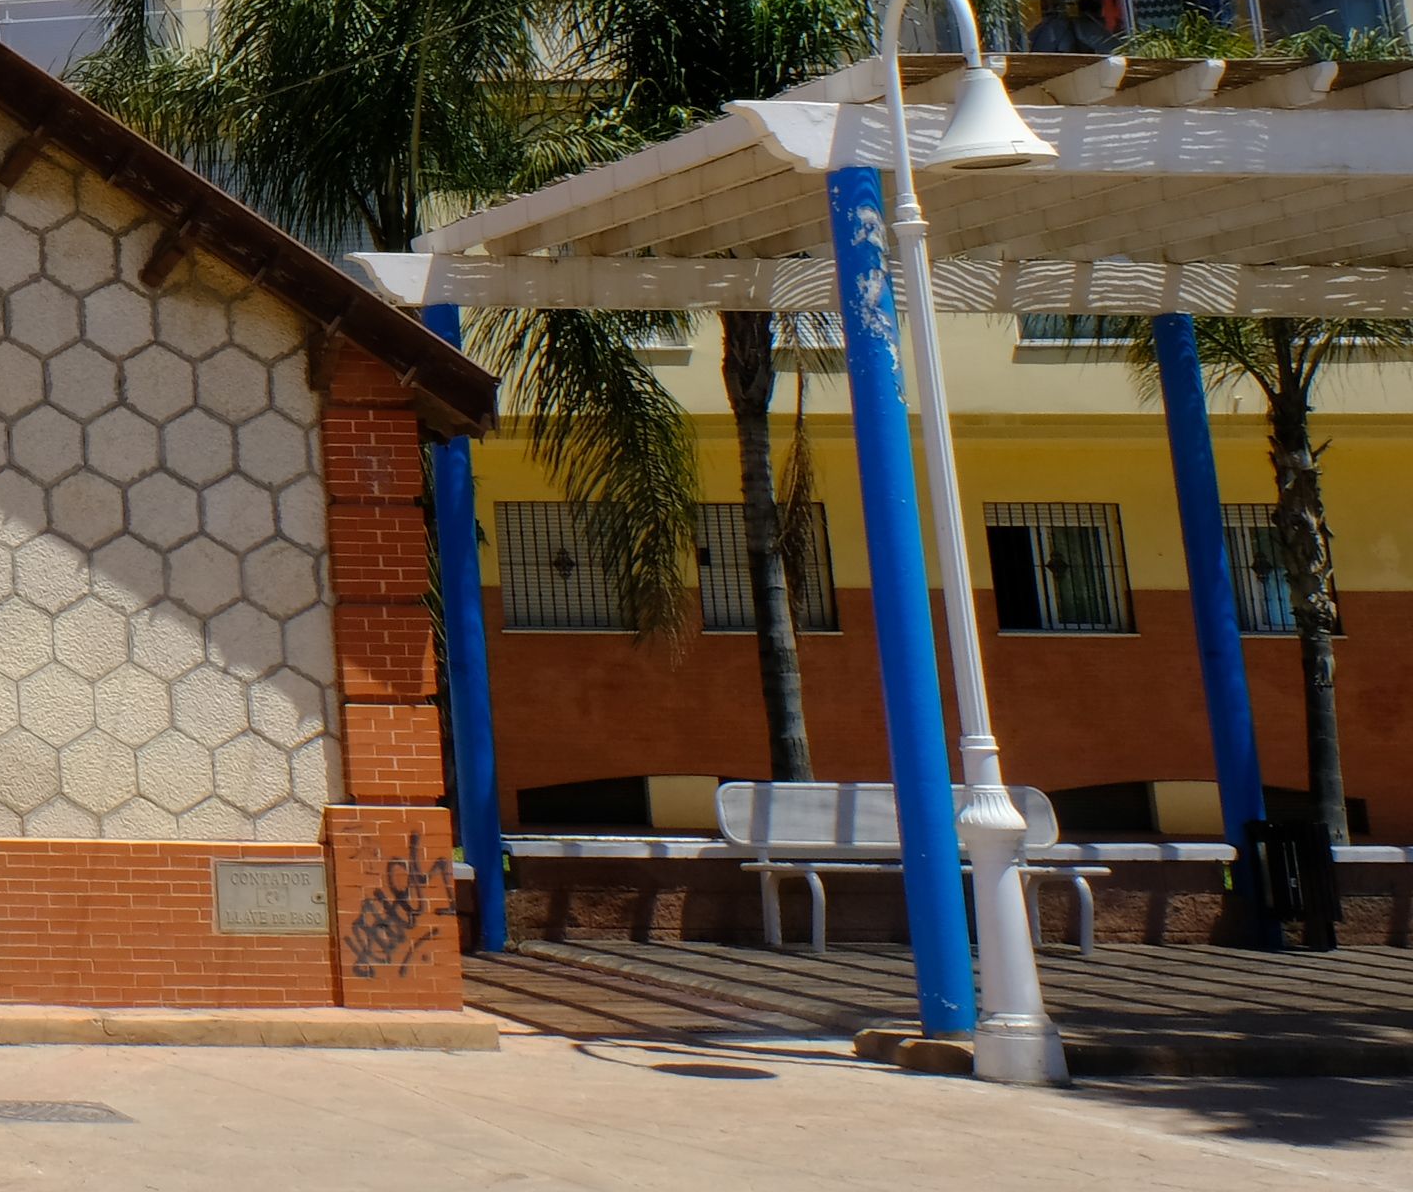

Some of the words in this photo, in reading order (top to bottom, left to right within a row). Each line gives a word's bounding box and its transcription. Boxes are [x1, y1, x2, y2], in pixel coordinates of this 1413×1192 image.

[230, 871, 311, 886] CONTADOR
[225, 909, 268, 925] LLAVE
[290, 911, 322, 926] PASO
